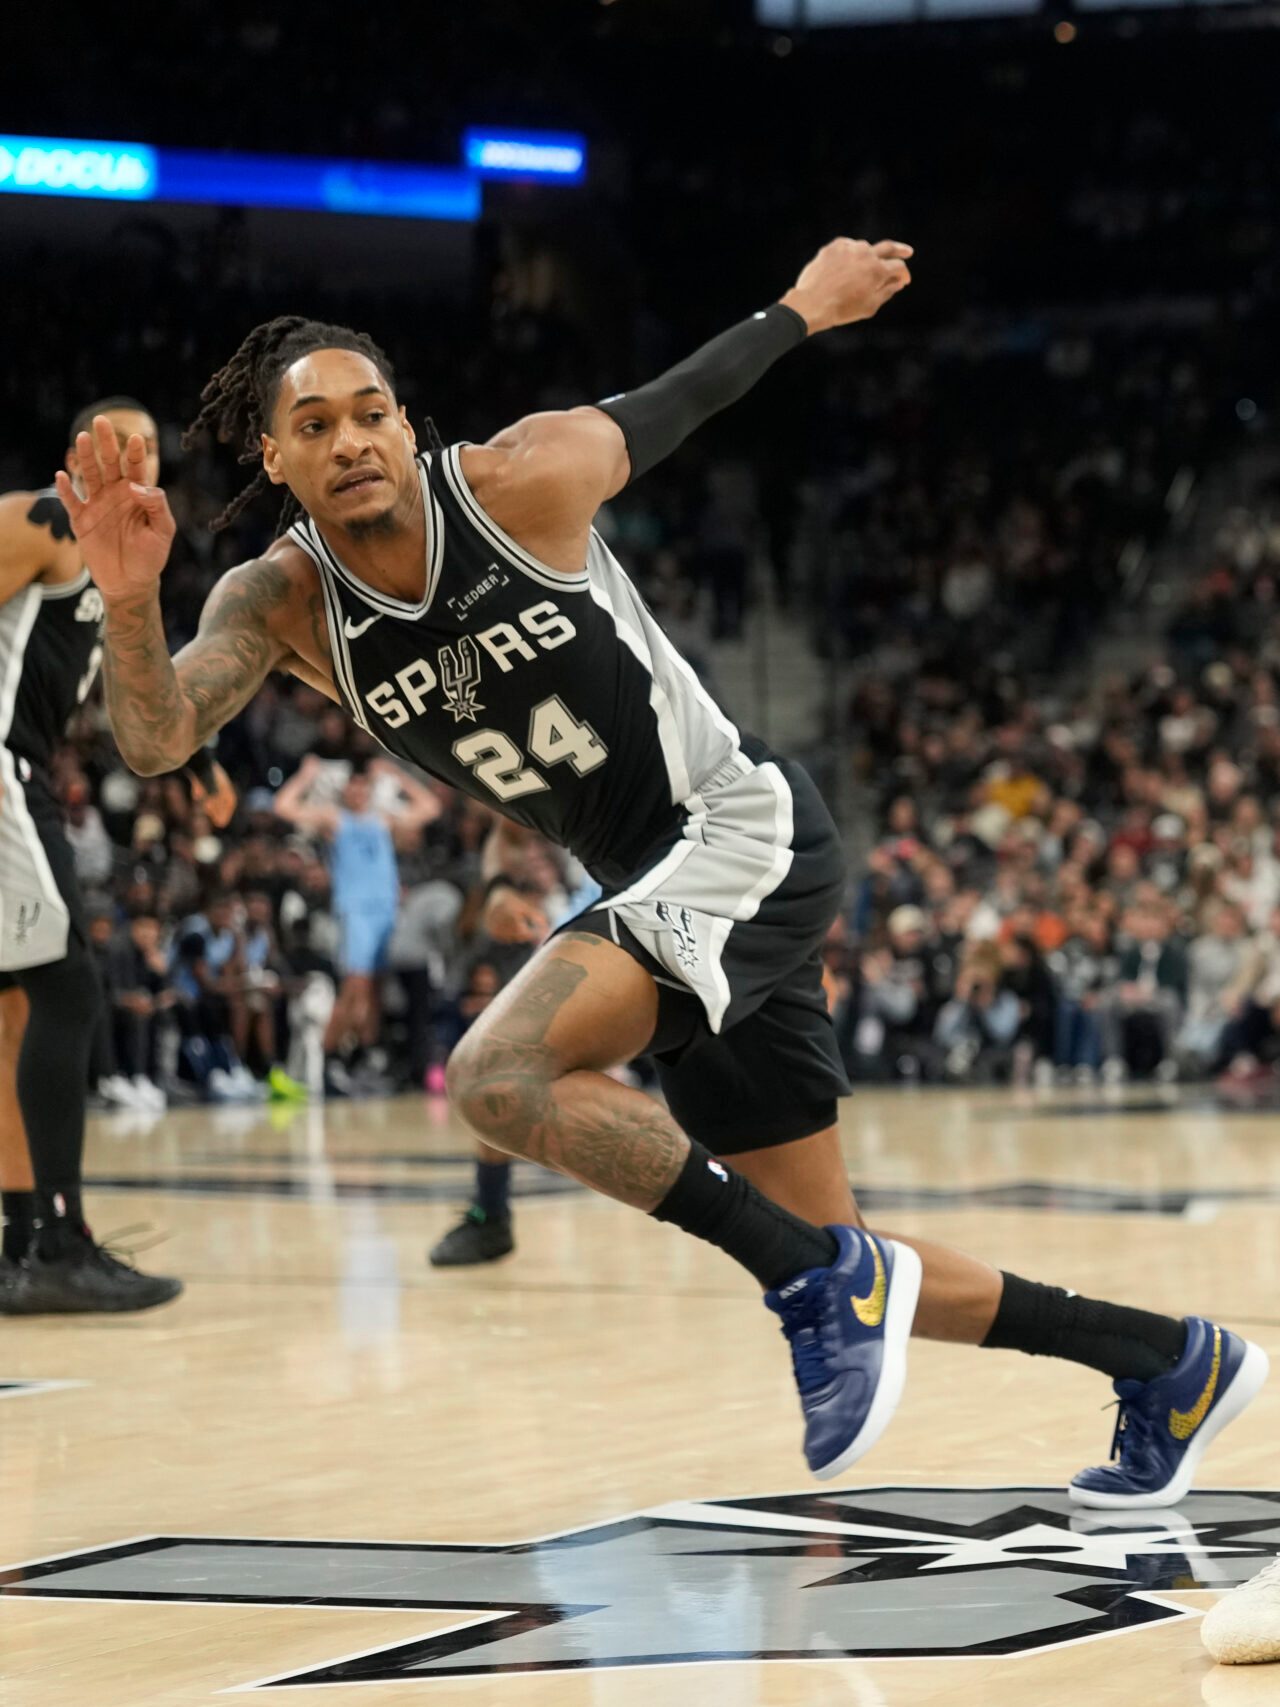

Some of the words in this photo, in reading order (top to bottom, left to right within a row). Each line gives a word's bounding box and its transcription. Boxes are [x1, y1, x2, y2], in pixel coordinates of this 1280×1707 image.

[455, 572, 501, 612] LEDGER
[365, 600, 577, 729] SPURS
[452, 694, 609, 804] 24
